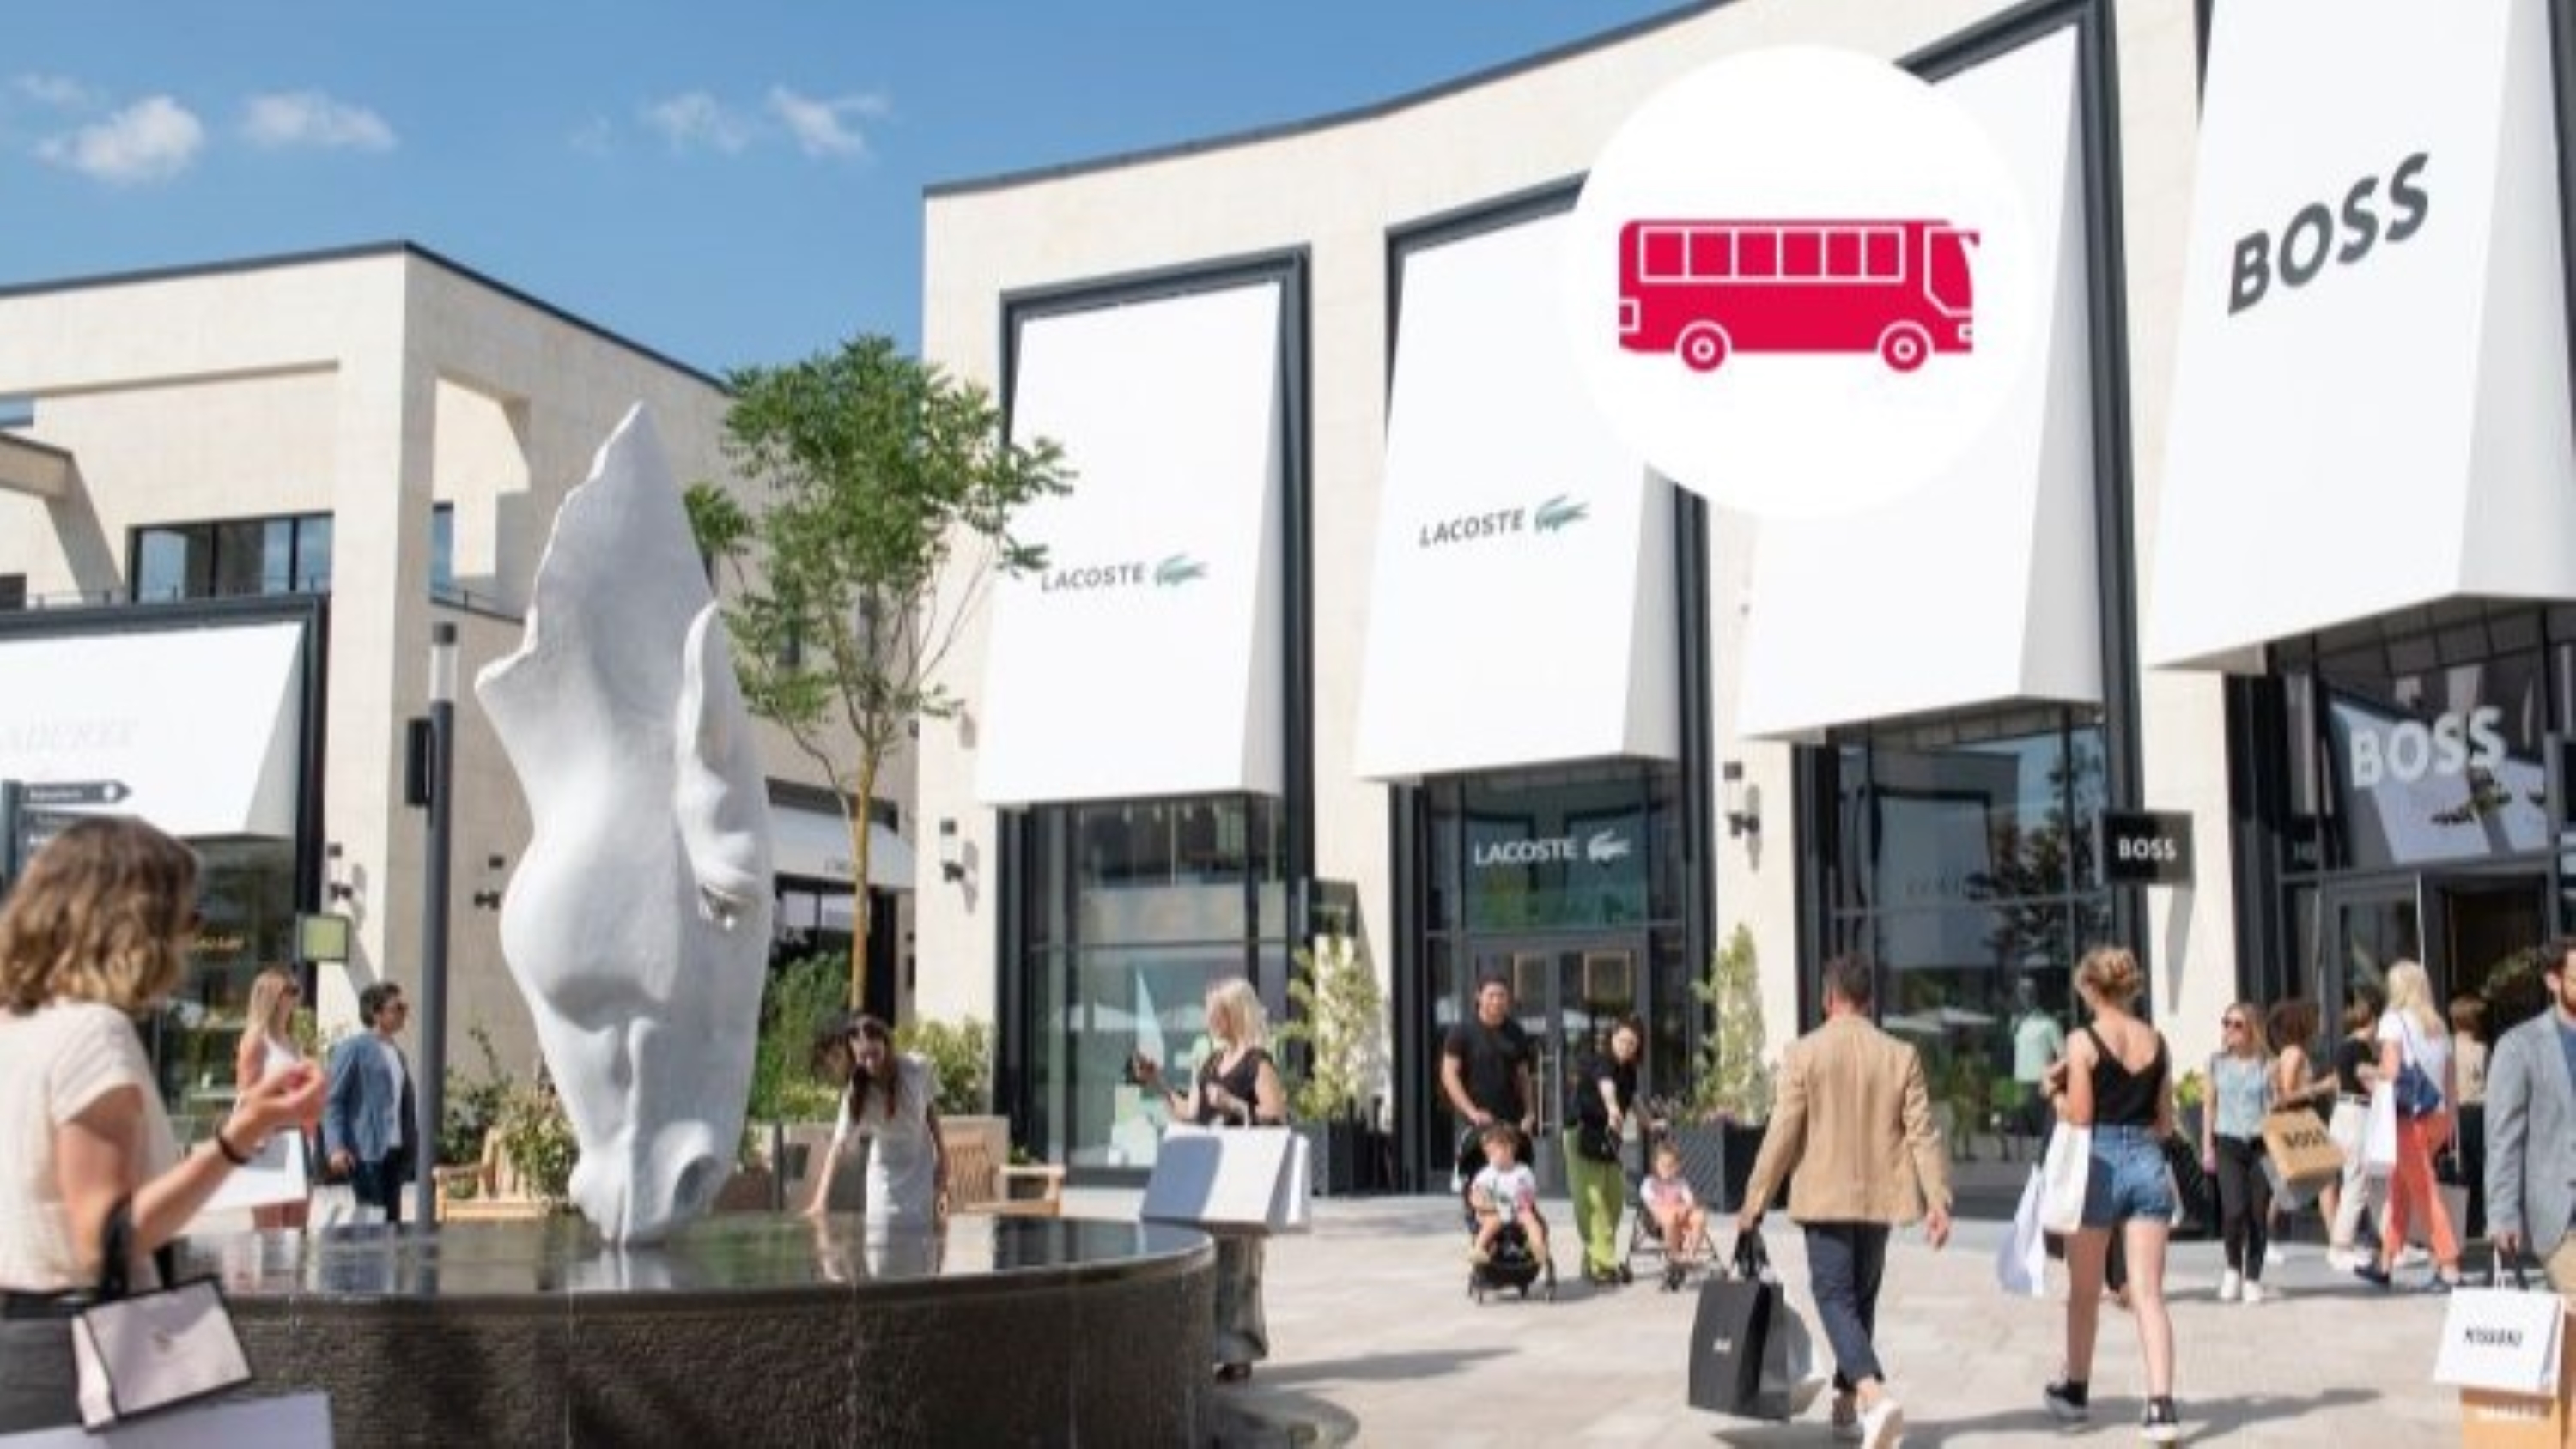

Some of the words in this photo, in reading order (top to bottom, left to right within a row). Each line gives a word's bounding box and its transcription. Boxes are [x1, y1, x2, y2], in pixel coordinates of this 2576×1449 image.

[2228, 151, 2429, 317] BOSS
[1419, 508, 1525, 548] LACOSTE
[1042, 562, 1144, 593] LACOSTE
[2351, 706, 2507, 788] BOSS
[1474, 836, 1578, 867] LACOSTE
[2118, 837, 2177, 861] BOSS
[2281, 1129, 2327, 1149] BOSS
